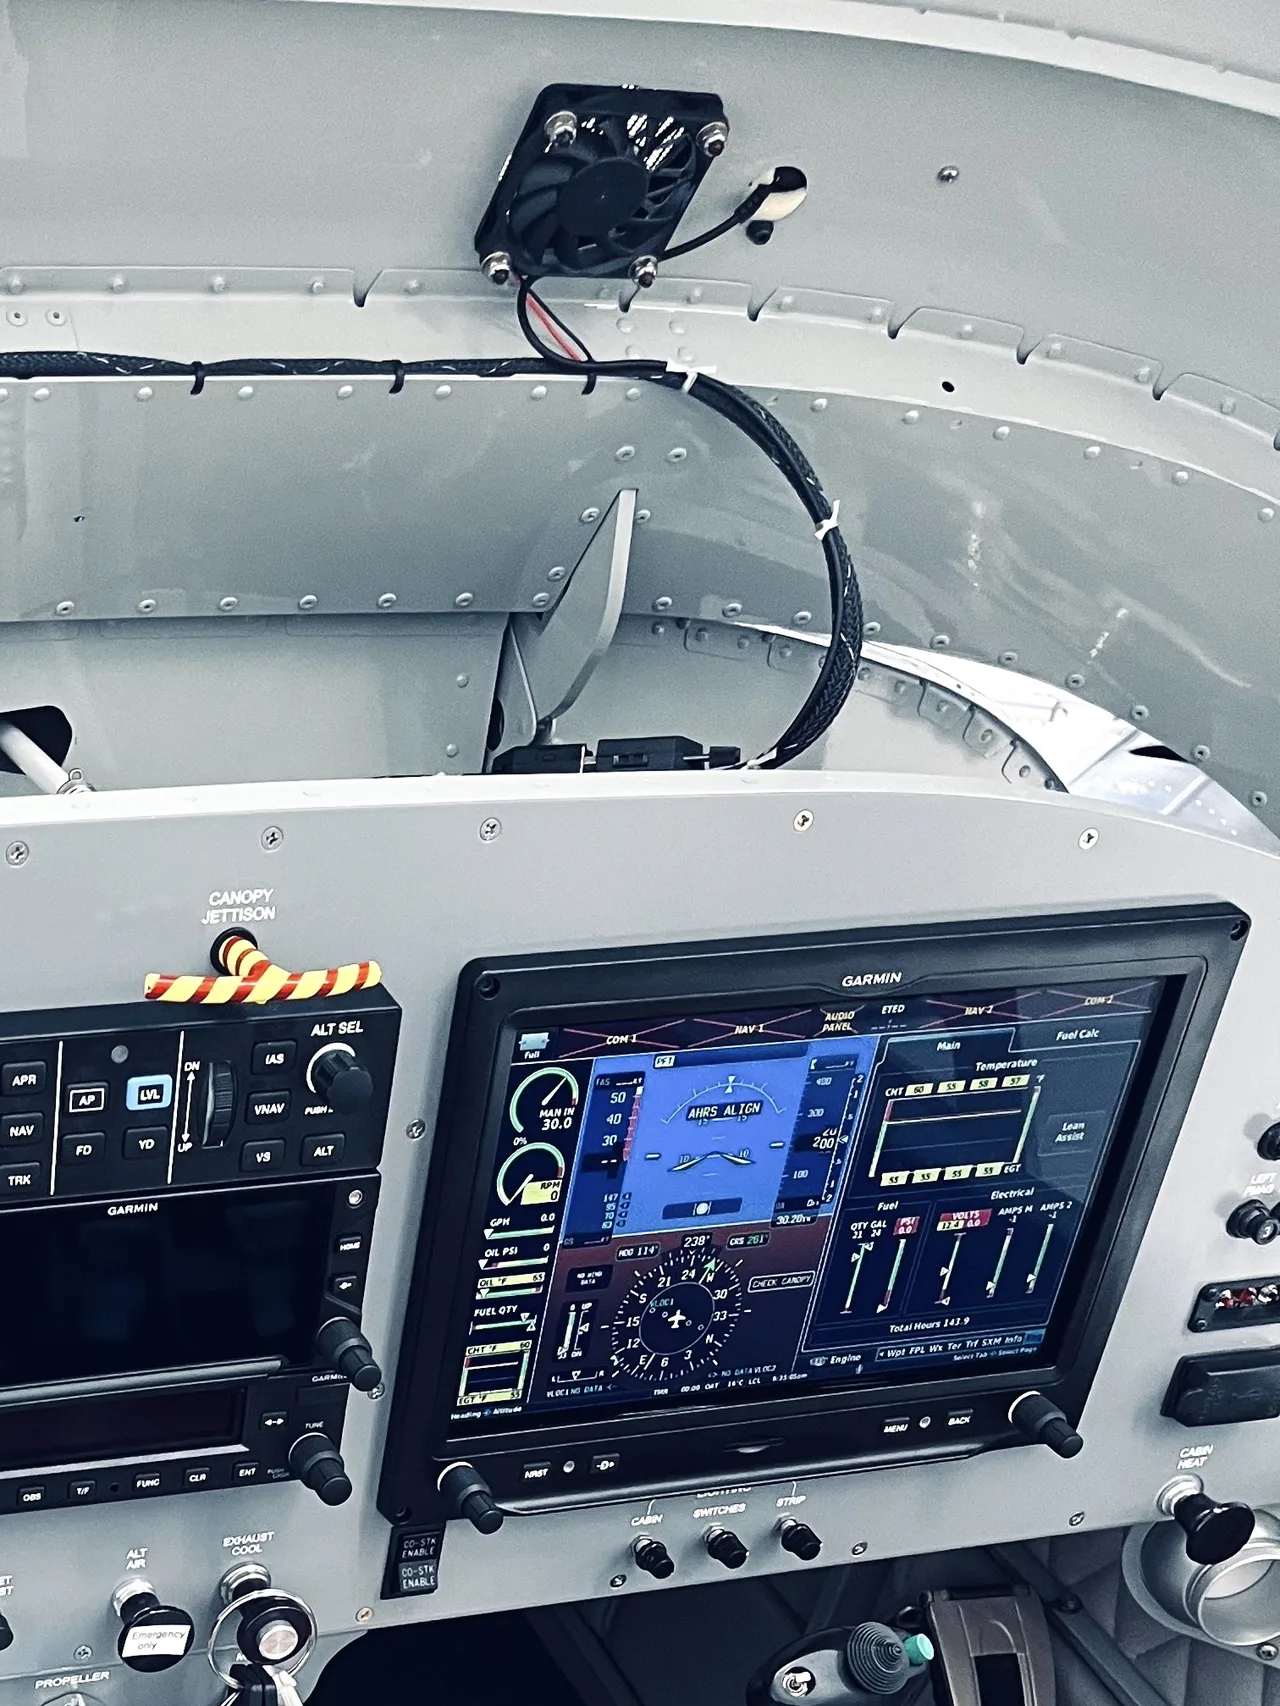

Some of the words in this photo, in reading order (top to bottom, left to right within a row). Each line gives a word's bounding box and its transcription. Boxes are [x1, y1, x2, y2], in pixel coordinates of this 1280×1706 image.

[208, 889, 274, 907] CANOPY
[201, 906, 276, 925] JETTISON
[842, 971, 902, 988] GARMIN
[311, 1022, 336, 1037] ALT
[339, 1021, 364, 1036] SEL
[1056, 1030, 1077, 1040] Fuel
[1079, 1027, 1099, 1039] Calc
[937, 1039, 960, 1052] Main
[265, 1053, 284, 1065] IAS
[975, 1057, 1038, 1071] Temperature
[184, 1062, 200, 1072] DN
[12, 1074, 36, 1087] APR
[78, 1094, 96, 1106] AP
[140, 1089, 160, 1102] LVL
[254, 1102, 284, 1115] VNAV
[688, 1105, 718, 1118] AHRS
[724, 1102, 760, 1116] ALIGN
[9, 1124, 34, 1137] NAV
[1062, 1121, 1085, 1132] Lean
[1055, 1131, 1084, 1143] Assist
[75, 1144, 92, 1156] FD
[138, 1138, 154, 1151] YD
[177, 1142, 192, 1153] UP
[313, 1144, 333, 1157] ALT
[255, 1151, 271, 1164] VS
[8, 1173, 31, 1186] TRK
[1250, 1171, 1277, 1185] LEFT
[990, 1187, 1034, 1200] Electrical
[107, 1202, 158, 1216] GARMIN
[1179, 1444, 1213, 1458] CABIN
[1177, 1456, 1206, 1470] HEAT
[189, 1472, 207, 1484] CLR
[239, 1466, 256, 1478] ENT
[136, 1477, 160, 1489] FUNC
[776, 1495, 806, 1506] STRIP
[693, 1503, 746, 1518] SWITCHES
[631, 1513, 662, 1526] CABIN
[222, 1531, 275, 1549] EXHAUST
[404, 1537, 436, 1549] CO-STK
[127, 1547, 148, 1560] ALT
[231, 1543, 263, 1556] COOL
[402, 1546, 434, 1558] ENABLE
[125, 1558, 146, 1570] AIR
[402, 1565, 435, 1577] CO-STK
[403, 1577, 435, 1589] ENABLE
[132, 1630, 186, 1642] Emergency
[137, 1641, 158, 1651] only
[35, 1671, 110, 1689] PROPELLER
